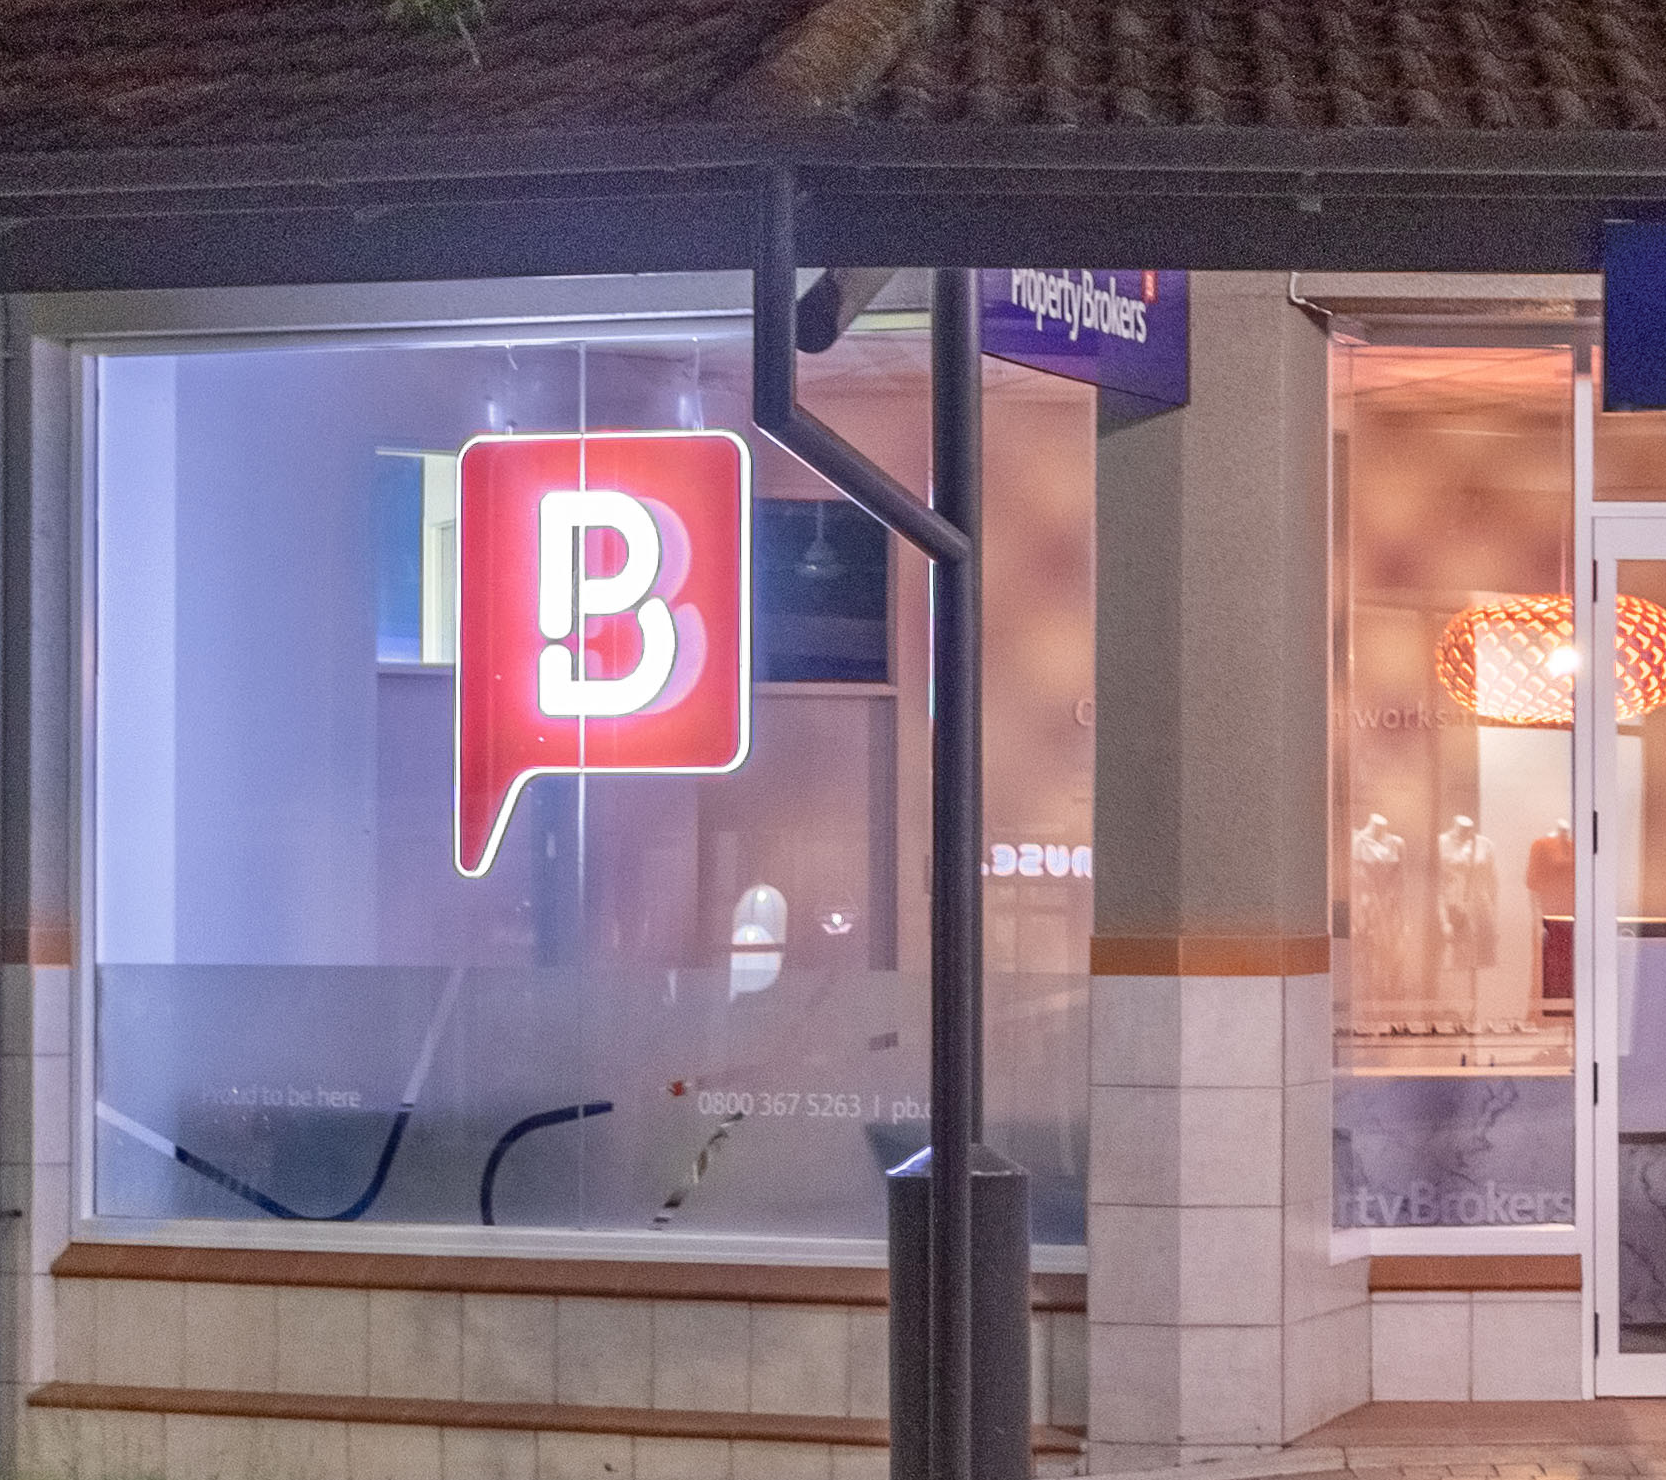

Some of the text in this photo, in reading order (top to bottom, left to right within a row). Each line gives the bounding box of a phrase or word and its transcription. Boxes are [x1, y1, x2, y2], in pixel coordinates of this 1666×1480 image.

[261, 1086, 284, 1107] to
[287, 1083, 314, 1107] be
[317, 1084, 363, 1109] here
[697, 1091, 755, 1117] 0800
[758, 1092, 799, 1117] 367
[805, 1093, 862, 1118] 5263
